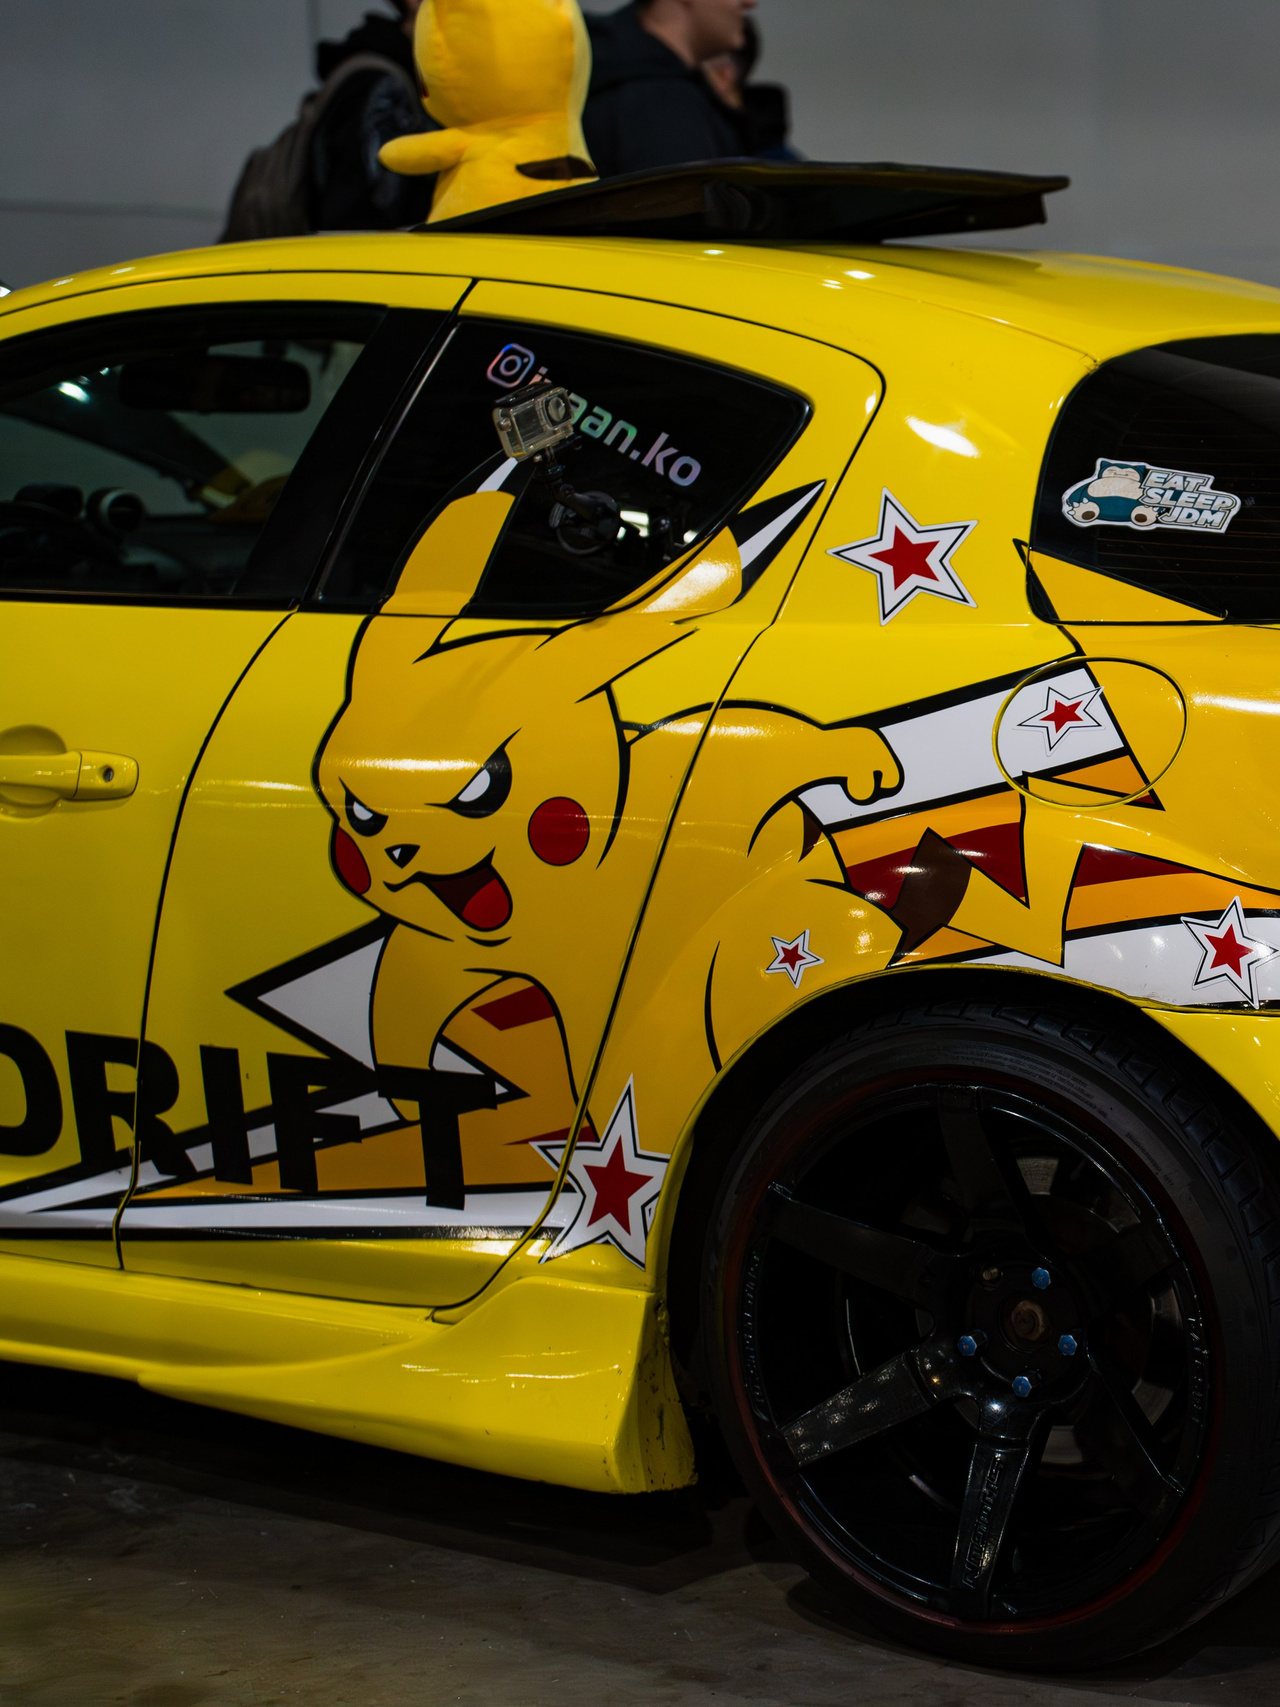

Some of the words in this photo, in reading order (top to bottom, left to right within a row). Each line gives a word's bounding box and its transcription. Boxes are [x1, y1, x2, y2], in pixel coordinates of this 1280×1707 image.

[1148, 472, 1204, 493] EAT
[1144, 488, 1233, 510] SLEEP
[1161, 507, 1224, 527] JDM
